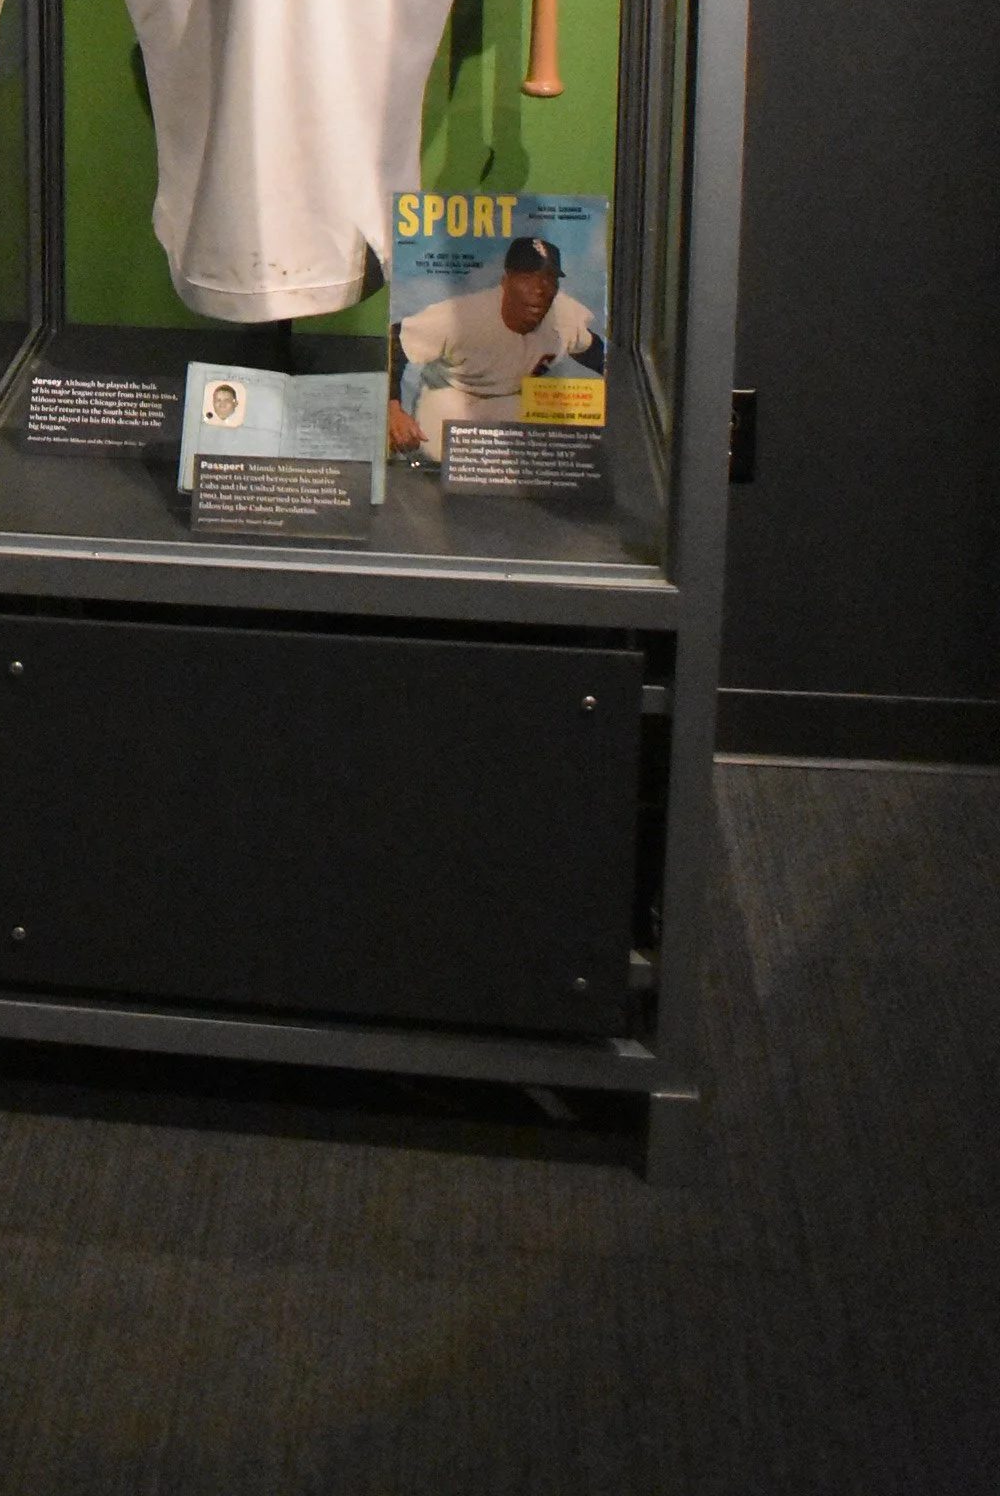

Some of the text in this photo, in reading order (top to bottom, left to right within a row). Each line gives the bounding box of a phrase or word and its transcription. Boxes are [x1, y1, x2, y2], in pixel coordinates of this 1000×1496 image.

[397, 193, 519, 239] SPORT
[32, 378, 61, 387] Jersey
[65, 379, 95, 388] Although
[106, 381, 128, 390] played
[31, 395, 56, 403] Miñoso
[75, 397, 88, 405] this
[89, 398, 116, 407] Chicago
[117, 399, 137, 408] jersey
[139, 400, 161, 409] during
[29, 413, 47, 421] when
[58, 414, 80, 423] played
[150, 419, 161, 427] the
[451, 427, 477, 436] Sport
[201, 462, 243, 472] Passport
